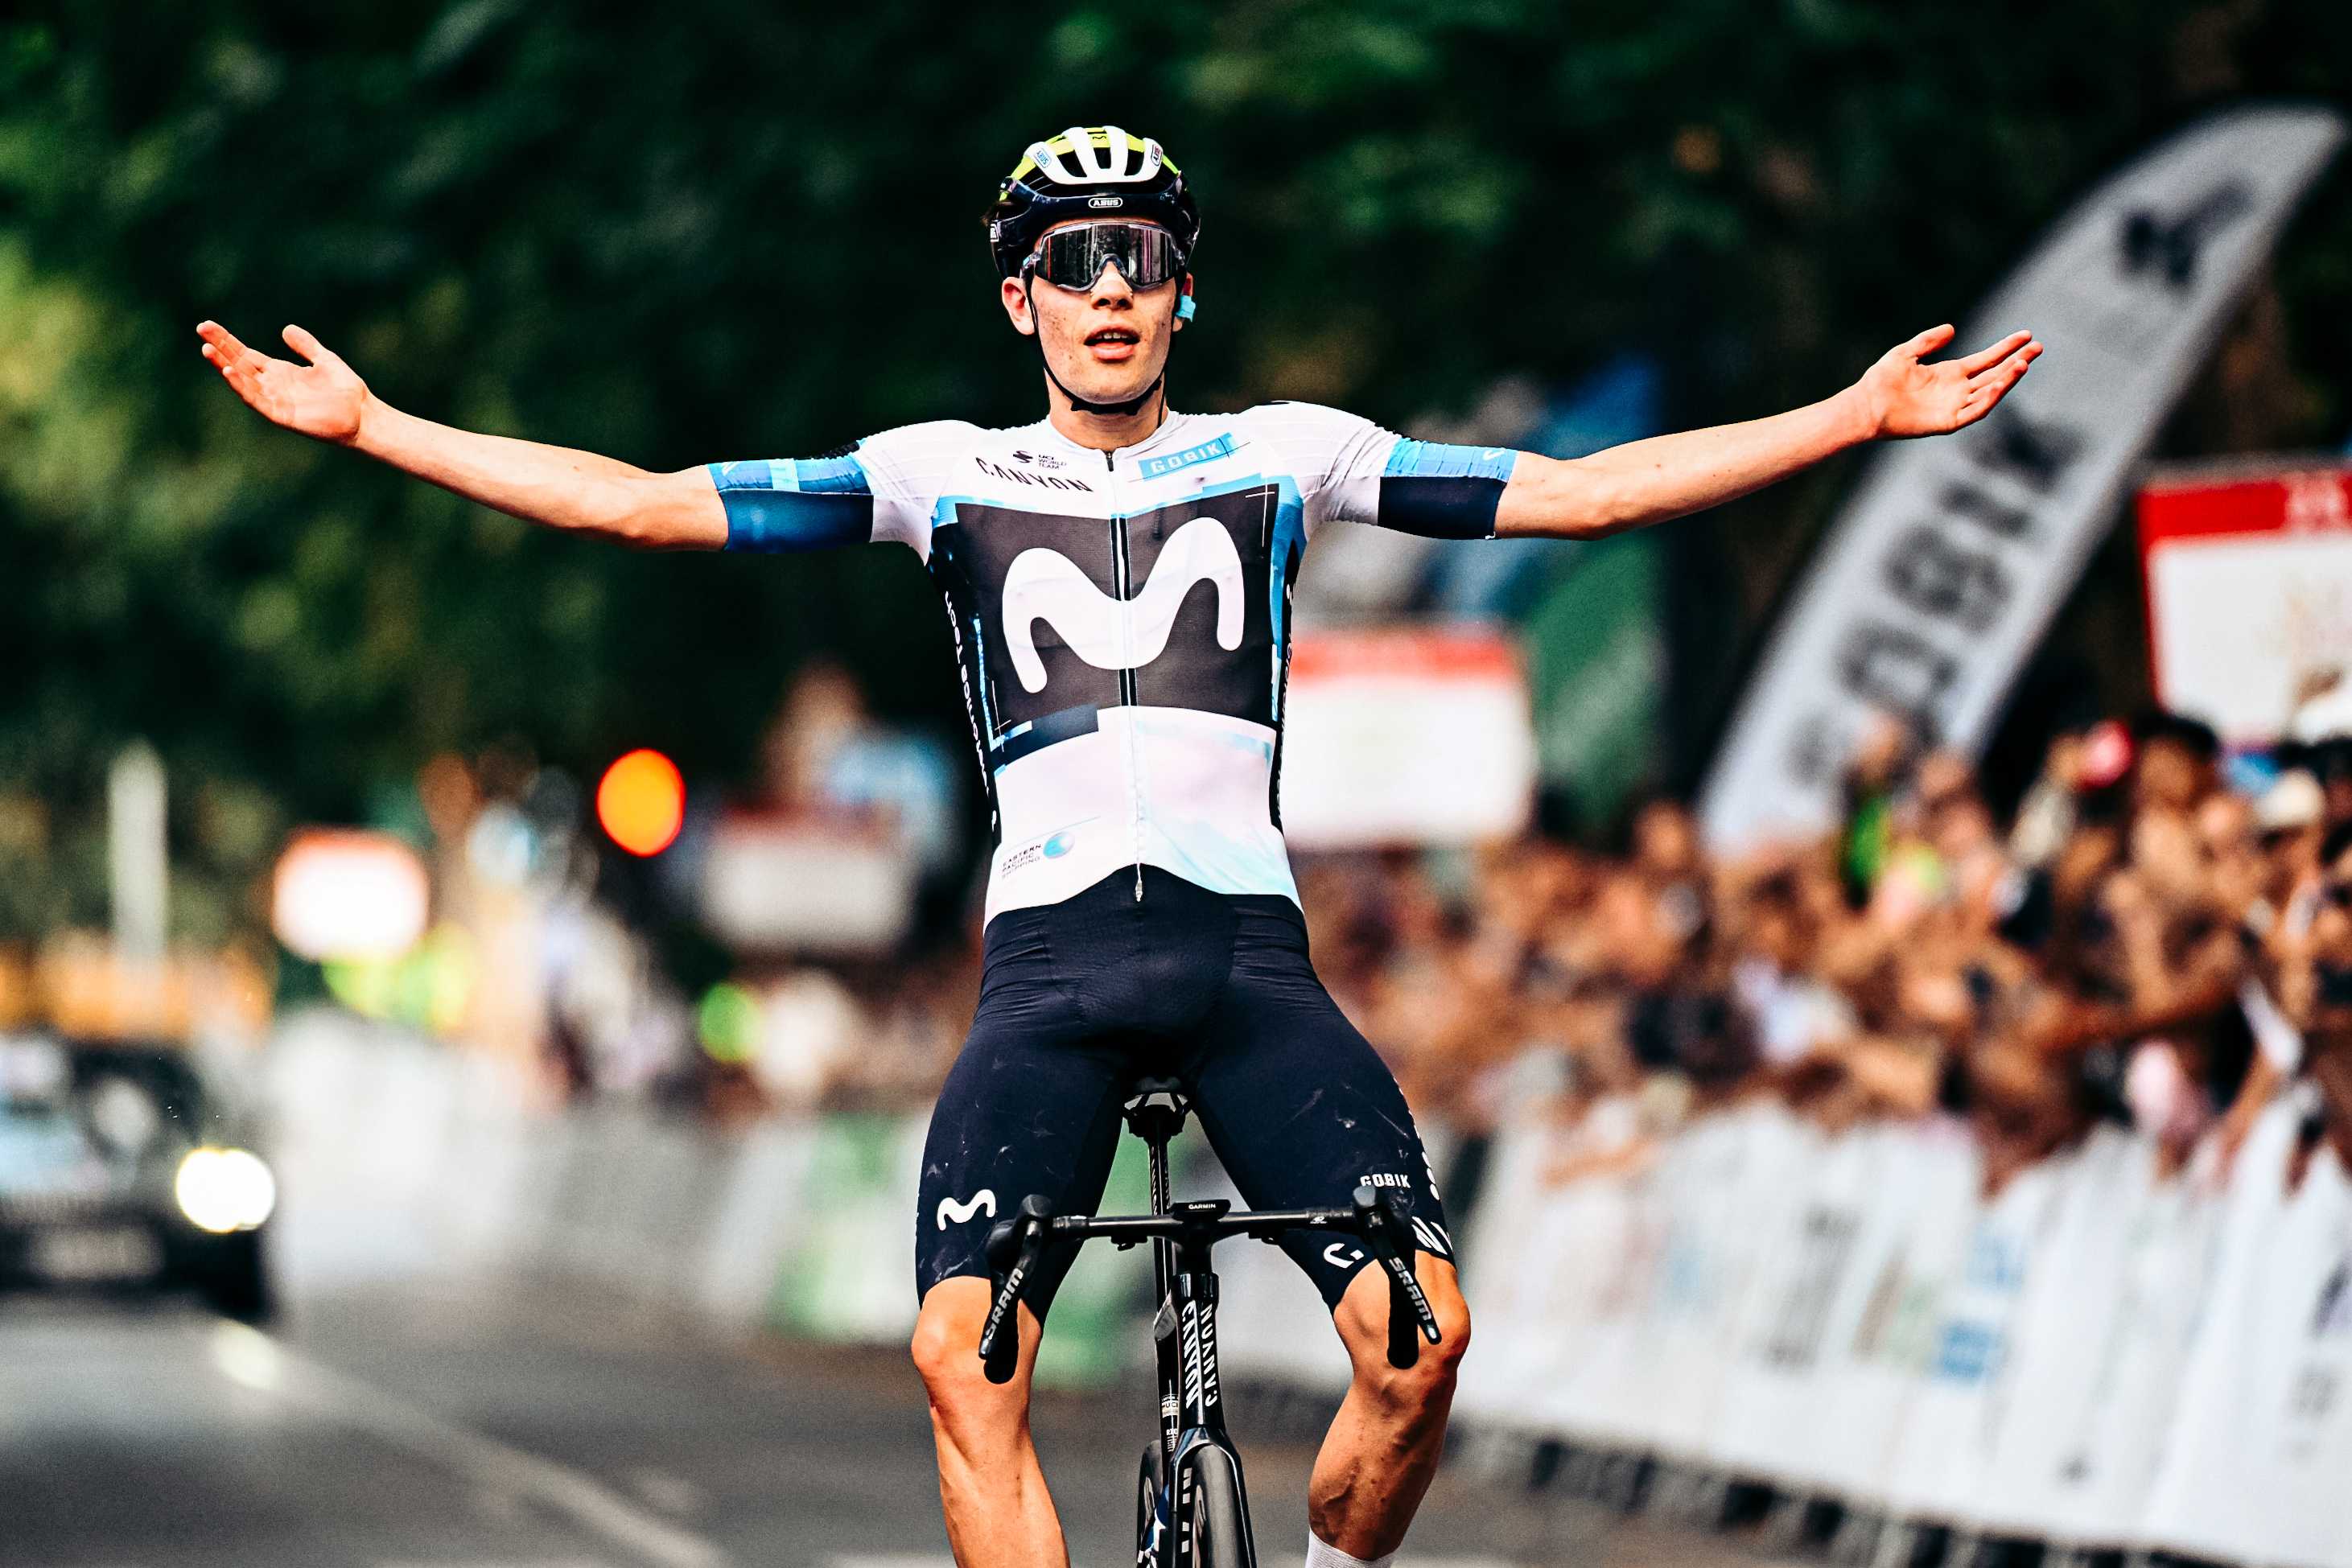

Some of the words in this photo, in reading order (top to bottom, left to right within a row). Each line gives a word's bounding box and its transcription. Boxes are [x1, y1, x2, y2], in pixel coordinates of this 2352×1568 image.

[975, 457, 1094, 492] CANYON
[1150, 442, 1221, 473] GOBIK
[1002, 853, 1035, 871] PACIFIC
[1003, 844, 1041, 867] EASTERN
[1360, 1173, 1411, 1188] GOBIK
[987, 1268, 1024, 1341] SRAM
[1389, 1256, 1432, 1322] SRAM
[1181, 1300, 1200, 1410] CANYON
[1200, 1303, 1218, 1408] CANYON
